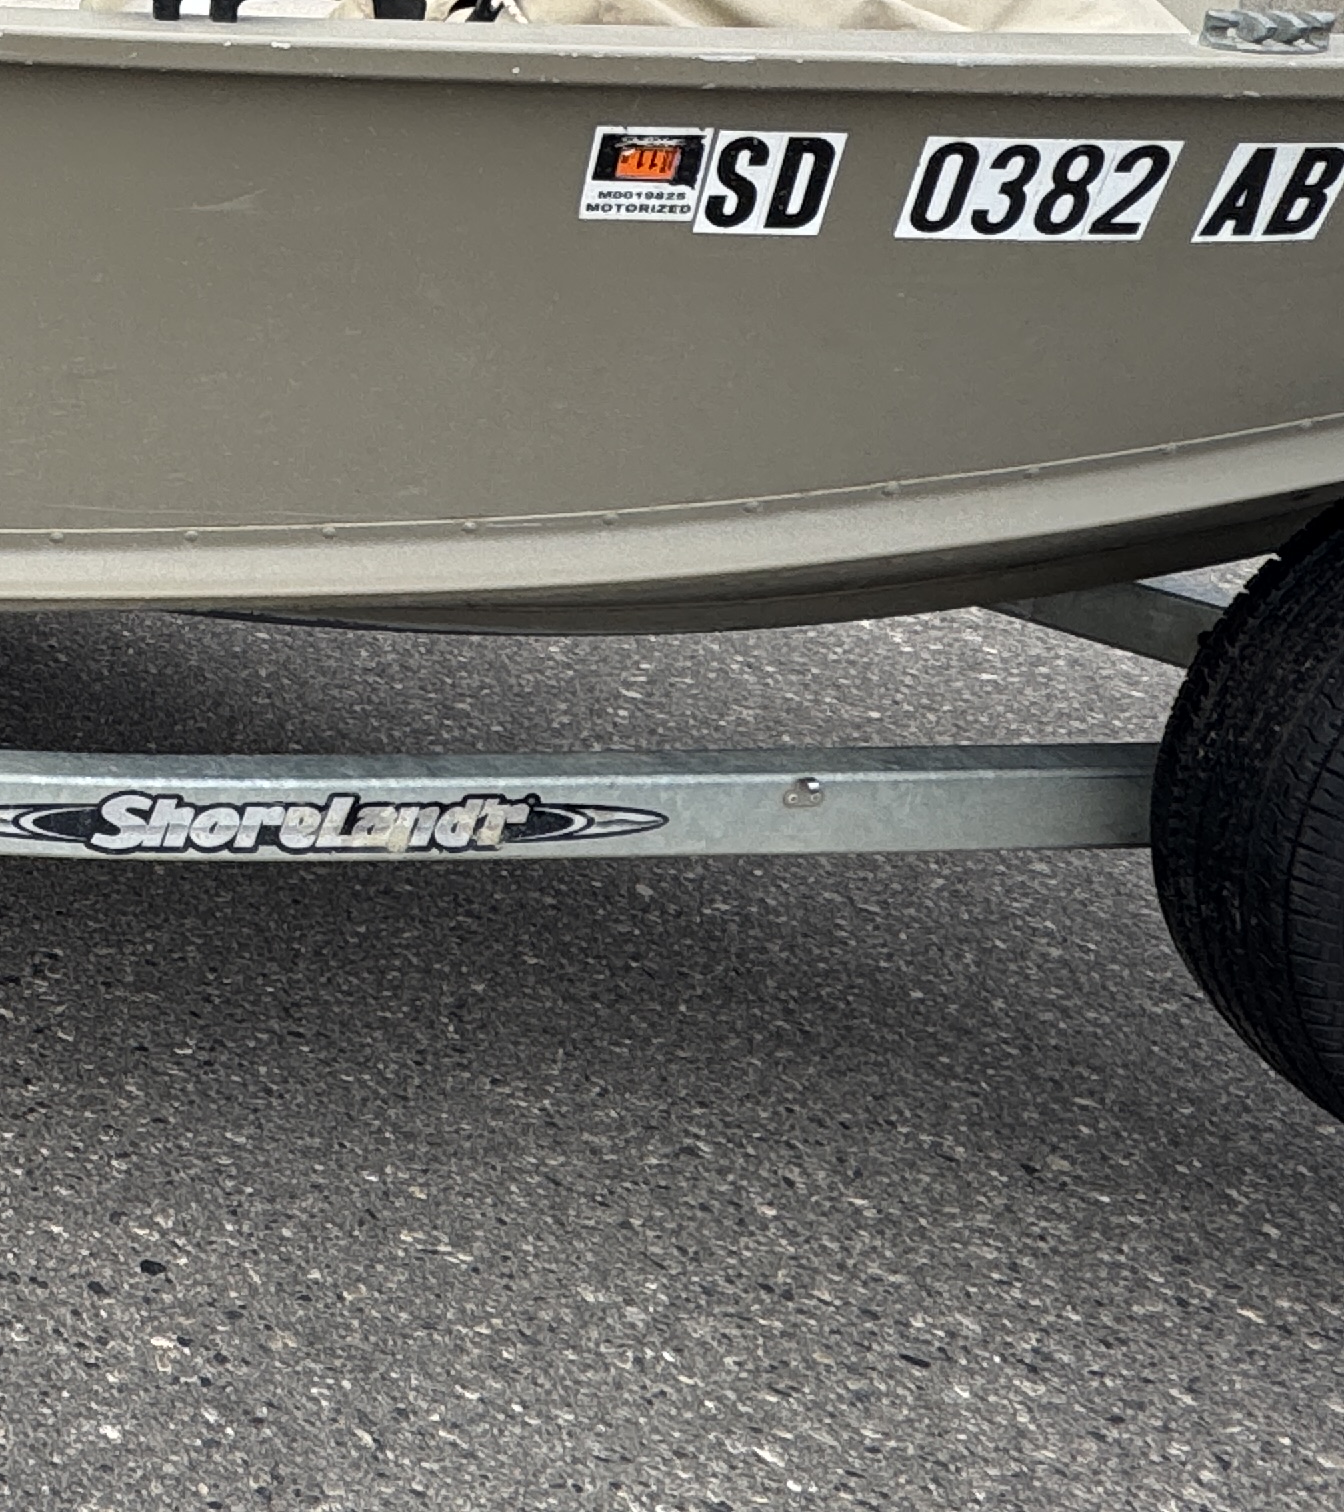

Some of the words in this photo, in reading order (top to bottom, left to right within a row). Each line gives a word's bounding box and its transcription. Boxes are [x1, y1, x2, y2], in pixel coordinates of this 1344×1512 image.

[585, 202, 692, 214] MOTORIZED
[703, 135, 837, 229] SD
[908, 141, 1177, 236] 0382
[1198, 146, 1344, 236] AB
